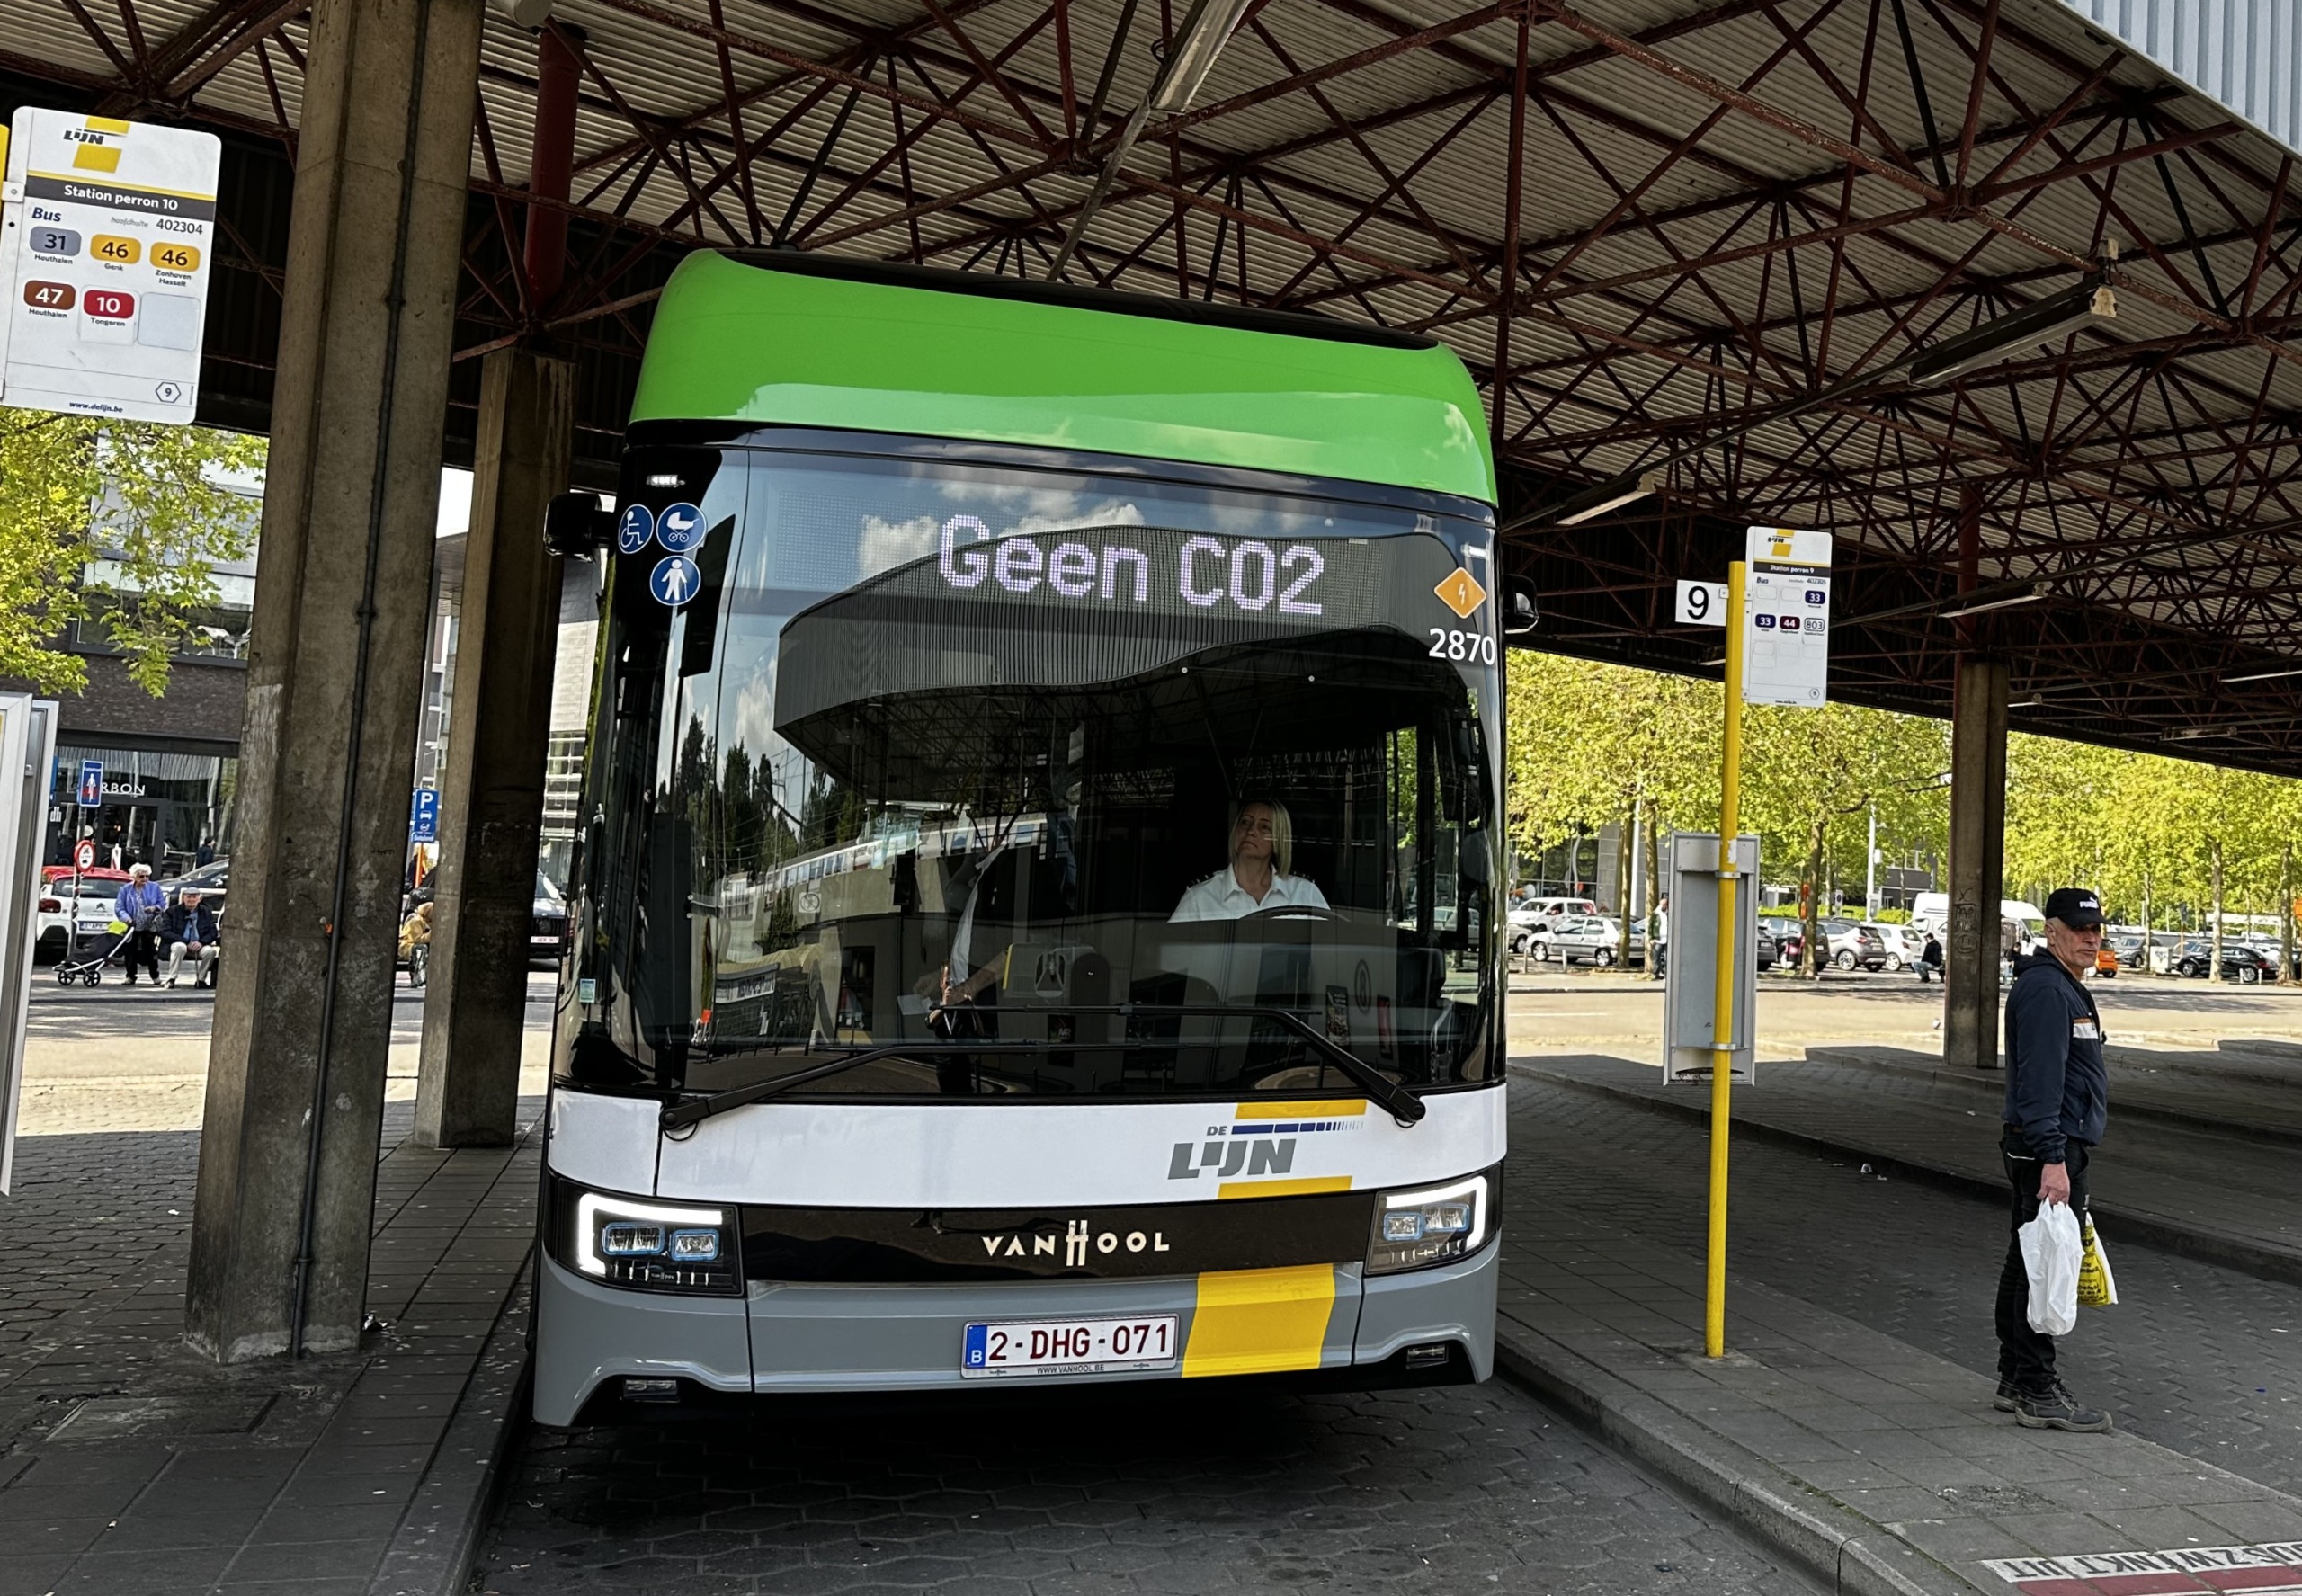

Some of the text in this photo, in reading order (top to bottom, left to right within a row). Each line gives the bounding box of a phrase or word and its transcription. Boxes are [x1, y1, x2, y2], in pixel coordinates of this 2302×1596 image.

[63, 129, 104, 145] LIJN
[64, 184, 178, 210] Station perron 10
[31, 206, 62, 222] Bus
[156, 218, 203, 235] 402304
[44, 233, 66, 250] 31
[101, 242, 129, 258] 46
[34, 254, 73, 265] Houthalen
[161, 250, 188, 266] 46
[104, 263, 123, 272] Genk
[156, 270, 192, 280] Zonhoven
[159, 278, 186, 287] Hasselt
[35, 288, 63, 304] 47
[96, 296, 120, 313] 10
[29, 308, 67, 318] Houthalen
[91, 317, 125, 327] Tongeren
[165, 388, 172, 397] 9
[69, 401, 123, 413] www.delijn.be
[939, 513, 1150, 602] Geen
[1756, 576, 1769, 584] Bus
[1687, 585, 1709, 620] 9
[1809, 593, 1821, 602] 33
[1759, 617, 1771, 626] 33
[1783, 619, 1796, 628] 44
[1806, 620, 1823, 629] 803
[1428, 628, 1496, 665] 2870
[420, 792, 433, 809] P
[1207, 1125, 1228, 1136] DE
[1167, 1138, 1297, 1180] LIJN
[971, 1350, 983, 1364] B
[1037, 1364, 1105, 1375] WWW.VANHOOL.BE
[2003, 1560, 2063, 1578] UIT
